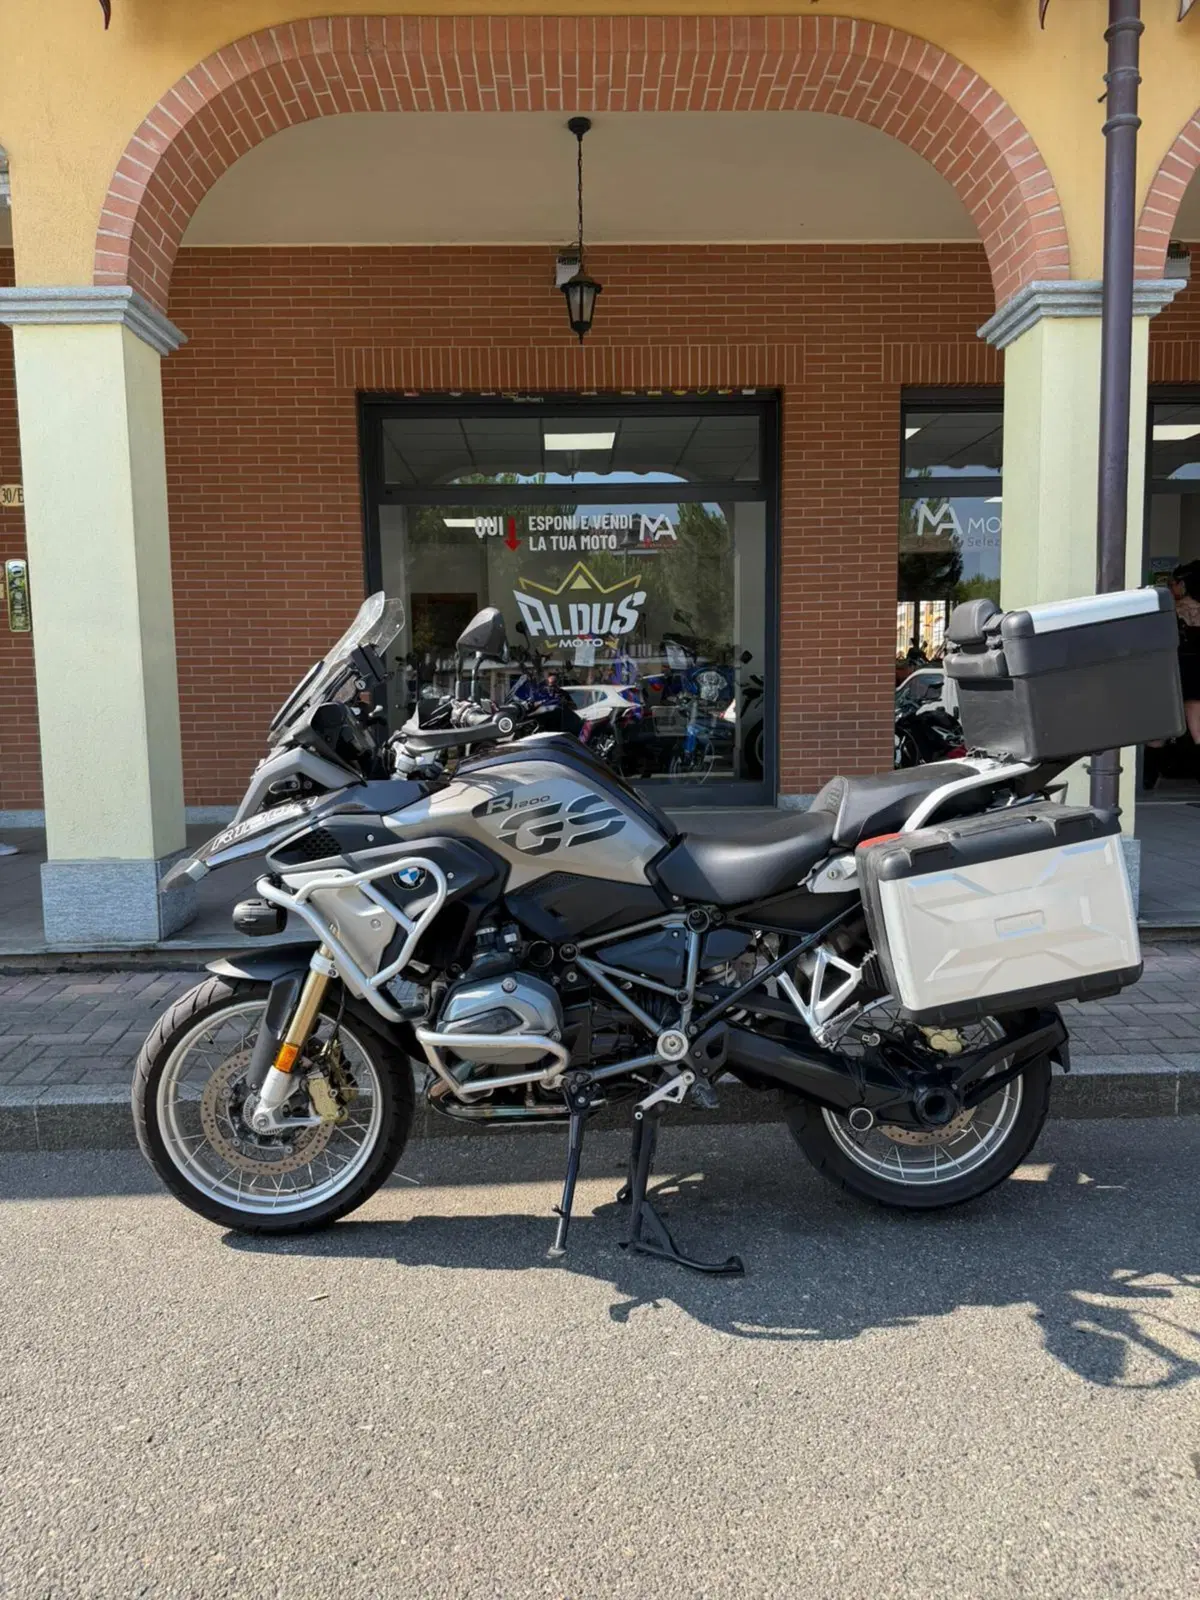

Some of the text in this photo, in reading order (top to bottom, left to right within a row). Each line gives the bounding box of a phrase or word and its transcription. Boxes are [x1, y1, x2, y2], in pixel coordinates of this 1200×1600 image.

[475, 516, 504, 538] QUI
[528, 515, 633, 531] ESPONI E VENDI
[529, 534, 617, 551] LA TUA MOTO
[512, 589, 647, 637] ALDUS
[558, 638, 604, 648] MOTO
[496, 792, 626, 856] GS
